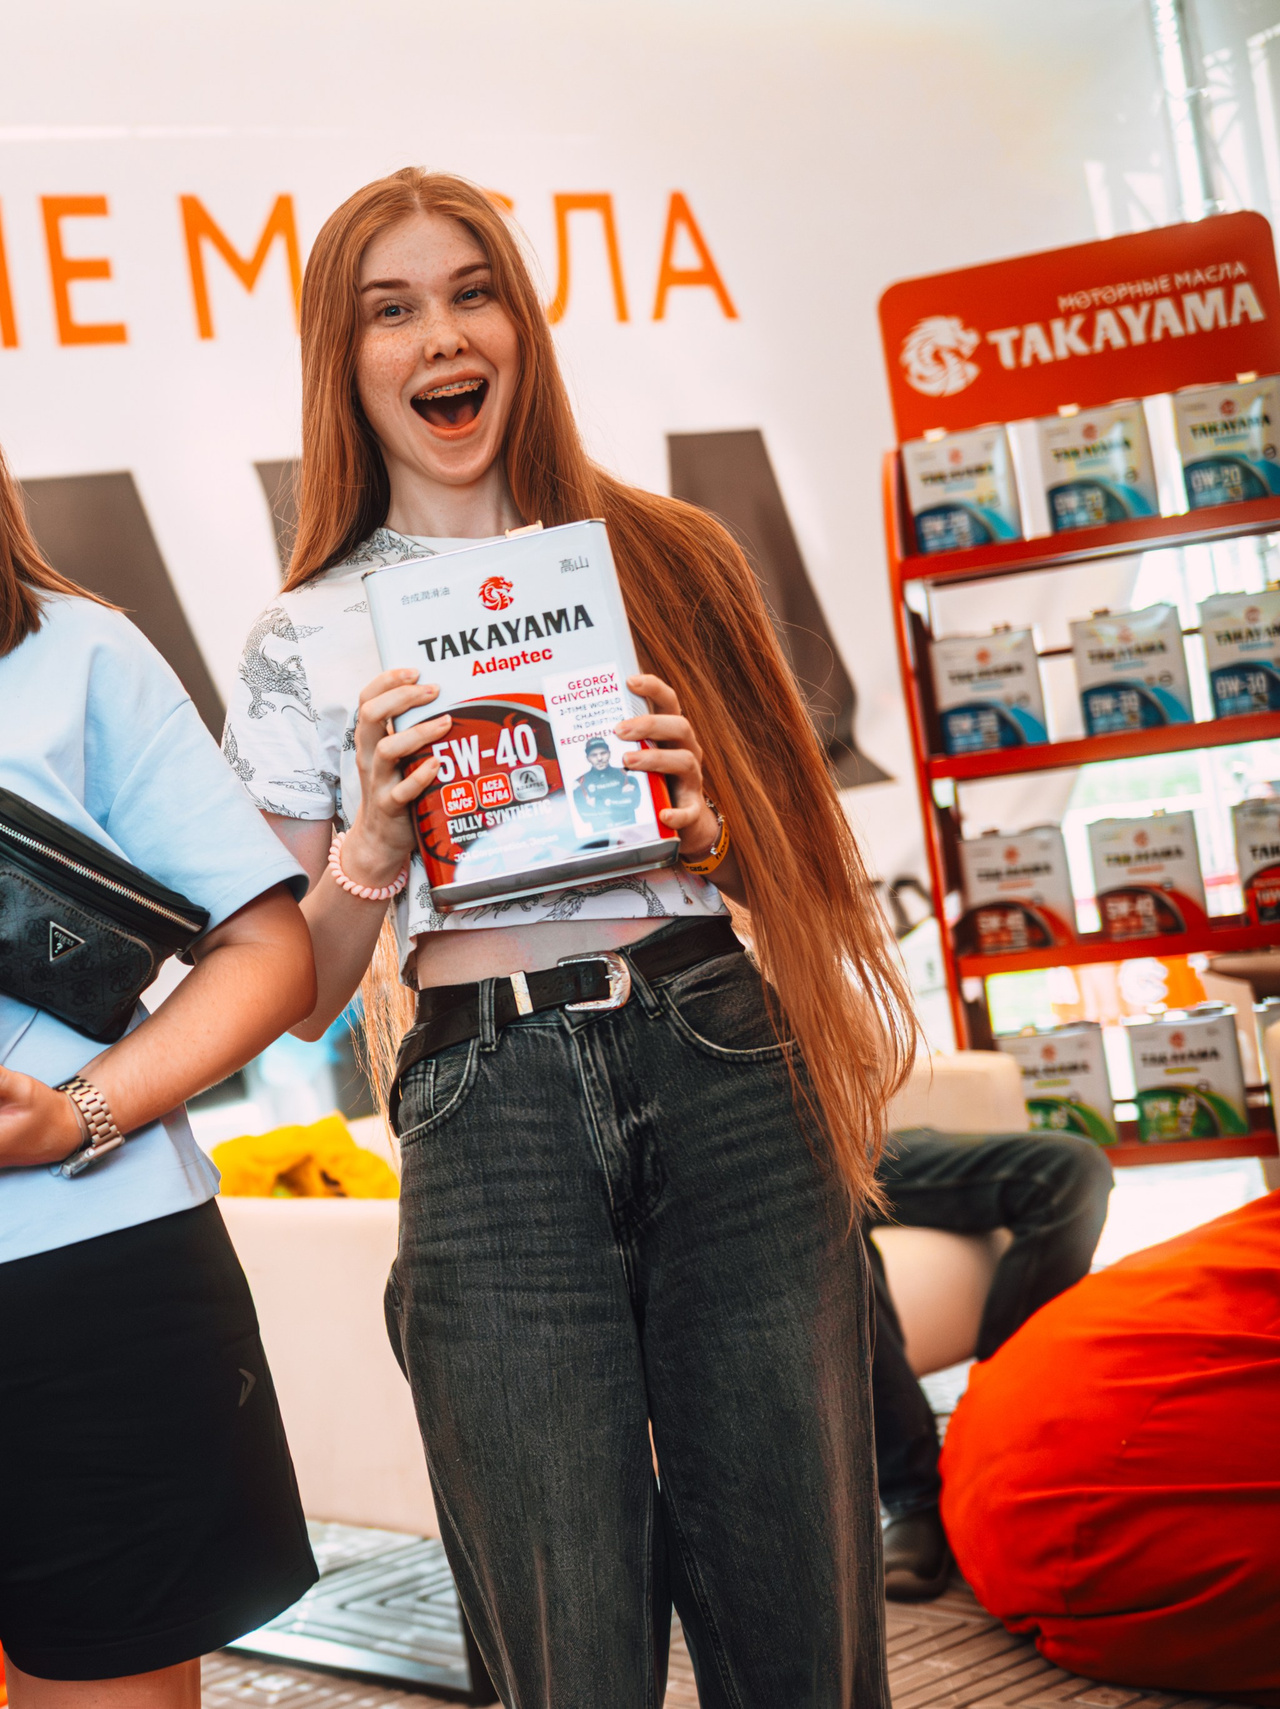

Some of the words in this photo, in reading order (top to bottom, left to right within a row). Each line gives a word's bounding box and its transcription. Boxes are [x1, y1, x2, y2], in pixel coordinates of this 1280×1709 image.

[178, 189, 740, 340] МЛА
[1057, 273, 1171, 312] МОТОРНЫЕ
[1173, 261, 1248, 291] МАСЛА
[986, 282, 1266, 370] TAKAYAMA
[559, 556, 590, 573] 高山
[418, 604, 594, 663] TAKAYAMA
[471, 647, 554, 677] Adaptec
[568, 673, 615, 690] GEORGY
[551, 684, 619, 705] CHIVCHYAN
[590, 697, 621, 709] WORLD
[560, 729, 617, 747] RECOMMEN
[432, 724, 538, 783] 5W-40
[451, 787, 466, 800] API
[482, 778, 505, 792] ACEA
[447, 796, 474, 812] SN/CF
[482, 788, 509, 805] A3/B4
[447, 813, 483, 835] FULLY
[485, 798, 552, 827] SYNTHETIC
